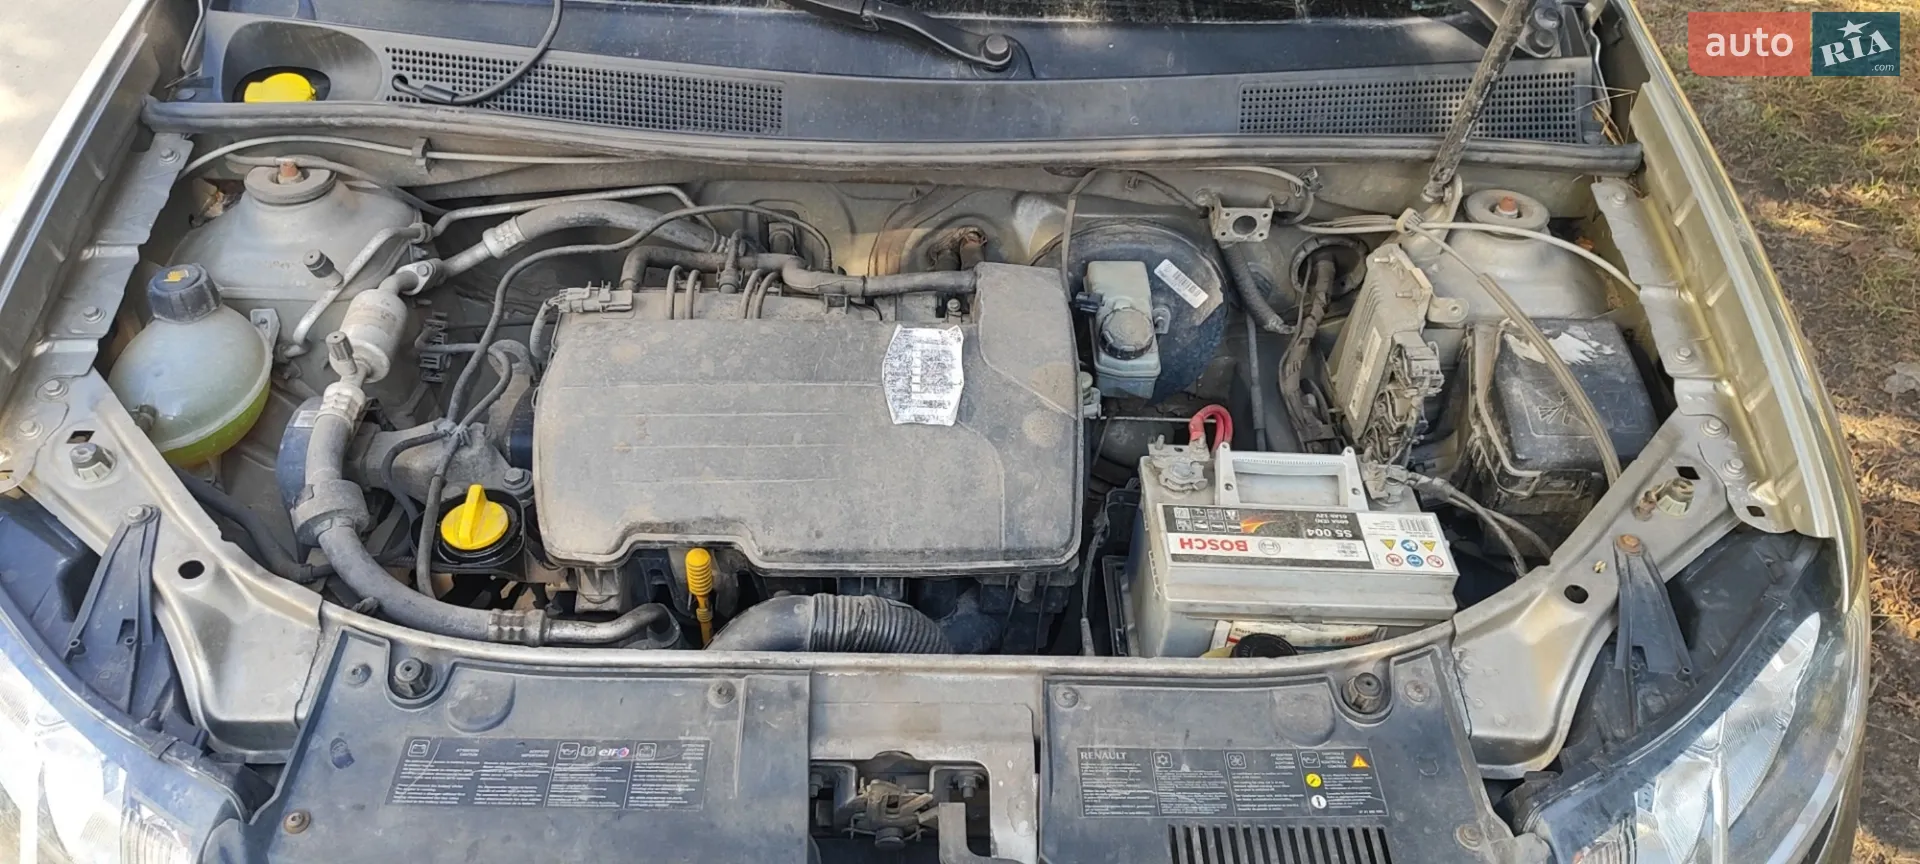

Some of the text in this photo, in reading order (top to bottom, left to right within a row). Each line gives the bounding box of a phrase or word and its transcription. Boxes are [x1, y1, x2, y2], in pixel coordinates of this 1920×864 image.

[1306, 528, 1353, 538] S5 004
[1179, 537, 1249, 552] BOSCH
[1080, 751, 1127, 760] RENAULT
